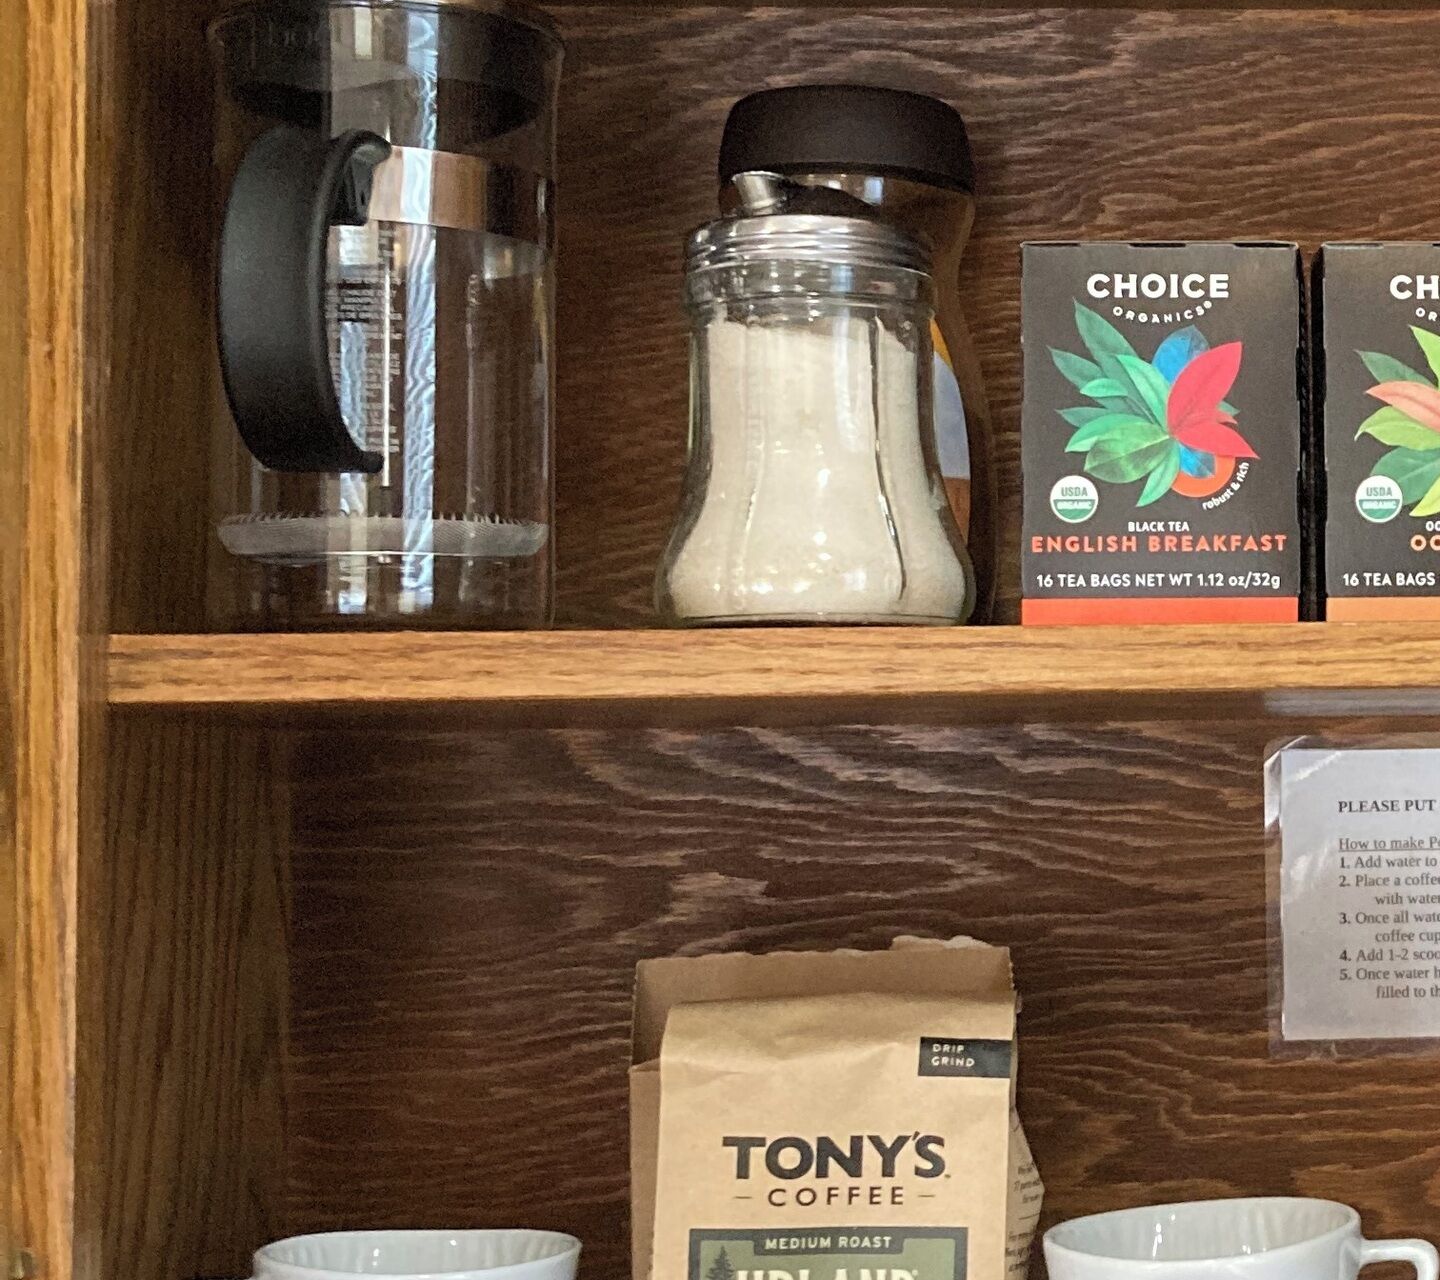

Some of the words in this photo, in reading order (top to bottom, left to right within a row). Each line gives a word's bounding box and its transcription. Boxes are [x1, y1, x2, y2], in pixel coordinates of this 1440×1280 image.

[1087, 273, 1229, 298] CHOICE
[1061, 487, 1088, 497] USDA
[1201, 488, 1235, 511] robust
[1236, 461, 1250, 482] rich
[1366, 487, 1392, 497] USDA
[1128, 522, 1164, 532] BLACK
[1168, 521, 1190, 532] TEA
[1031, 535, 1138, 552] ENGLISH
[1149, 534, 1288, 551] BREAKFAST
[1037, 574, 1054, 588] 16
[1058, 574, 1086, 587] TEA
[1091, 574, 1131, 587] BAGS
[1135, 573, 1164, 587] NET
[1168, 573, 1193, 587] WT
[1197, 573, 1224, 586] 1.12
[1229, 571, 1281, 590] oz/32g
[1343, 573, 1359, 587] 16
[1363, 573, 1393, 587] TEA
[1396, 573, 1436, 587] BAGS
[1338, 799, 1401, 813] PLEASE
[1405, 798, 1436, 811] PUT
[1339, 837, 1367, 851] How
[1373, 837, 1386, 850] to
[1390, 835, 1425, 850] make
[1355, 856, 1382, 868] Add
[1386, 857, 1421, 867] water
[1355, 873, 1389, 886] Place
[1374, 892, 1403, 905] with
[1355, 911, 1389, 924] Once
[1393, 910, 1409, 923] all
[1375, 929, 1415, 943] coffee
[1355, 948, 1383, 961] Add
[1388, 948, 1409, 960] 1-2
[1355, 967, 1390, 980] Once
[1394, 968, 1430, 979] water
[1375, 983, 1409, 997] filled
[1413, 985, 1426, 996] to
[932, 1043, 965, 1053] DRIP
[931, 1056, 976, 1067] GRIND
[722, 1131, 947, 1180] TONY'S
[768, 1186, 904, 1207] COFFEE
[765, 1237, 832, 1251] MEDIUM
[838, 1236, 892, 1250] ROAST
